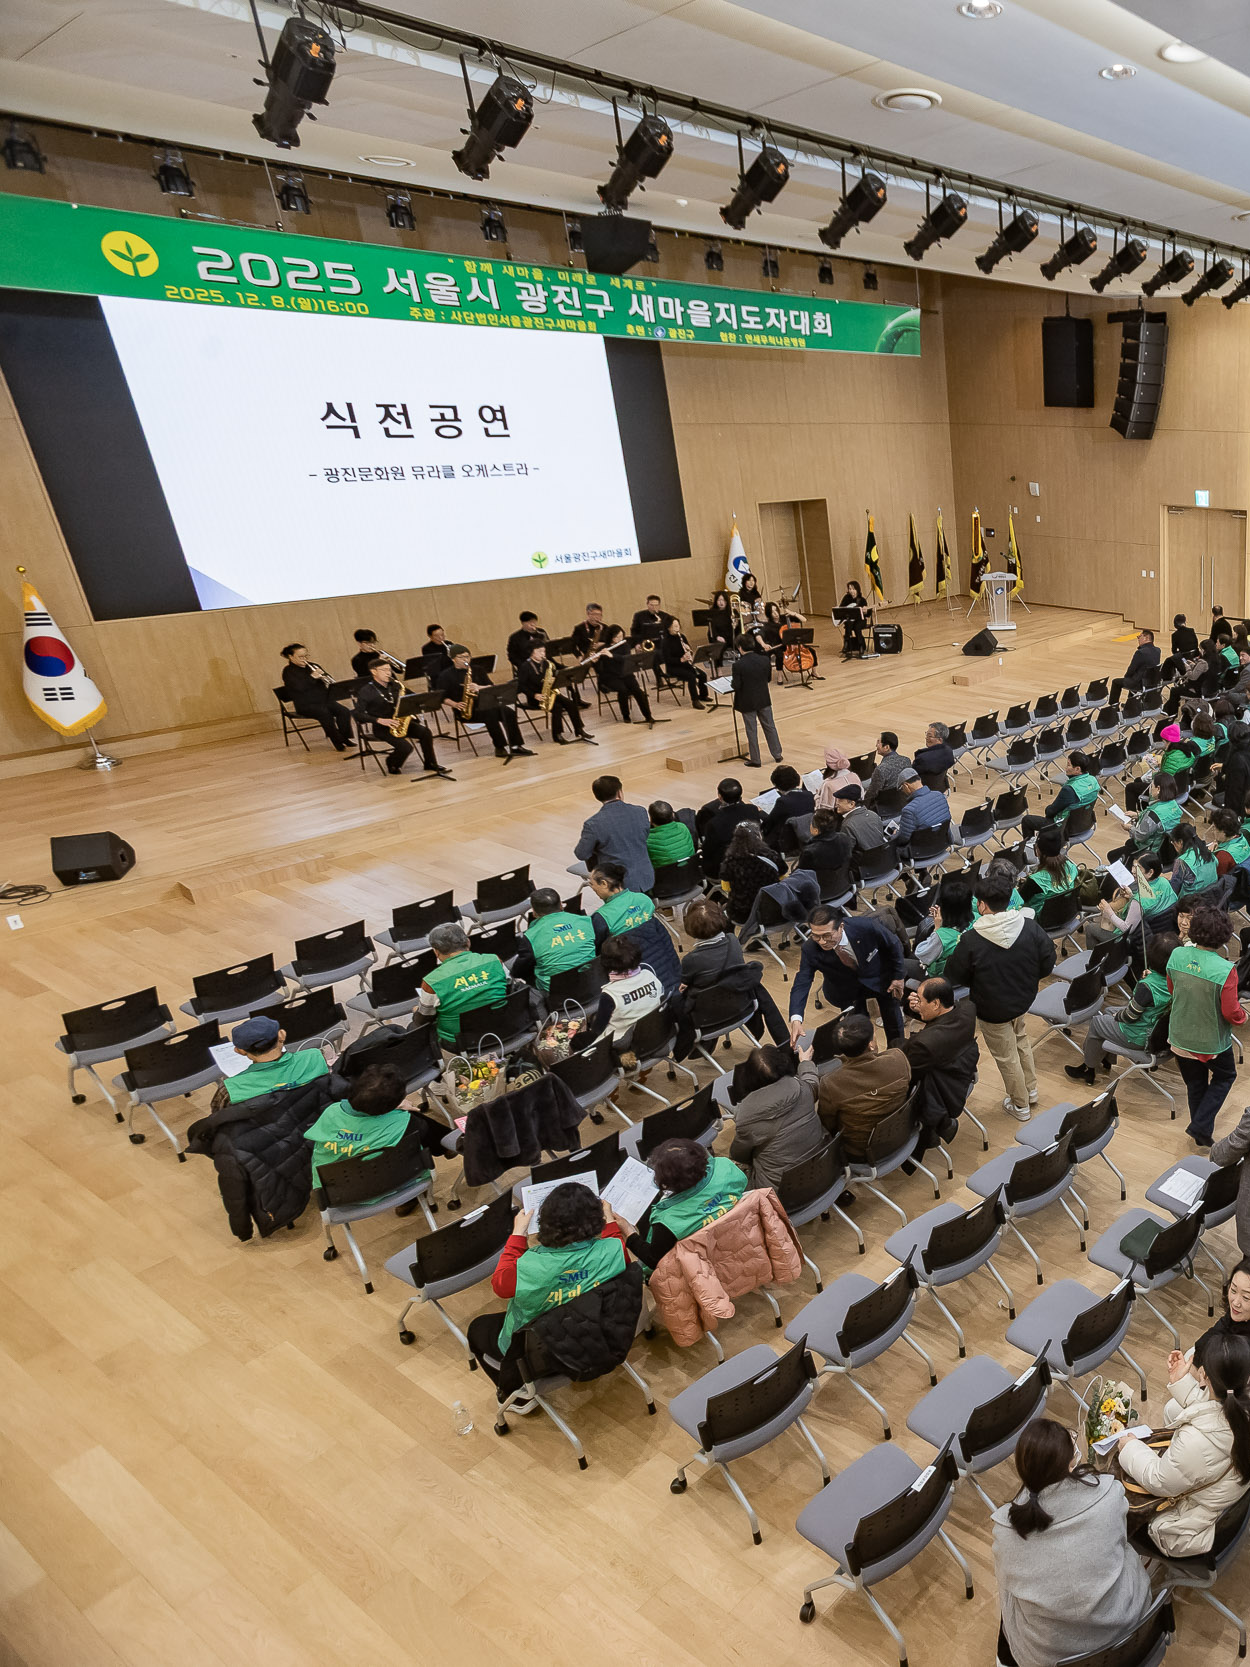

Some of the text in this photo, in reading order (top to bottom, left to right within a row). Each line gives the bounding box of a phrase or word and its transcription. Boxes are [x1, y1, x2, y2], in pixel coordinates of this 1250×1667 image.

[164, 285, 232, 304] 2025.
[236, 292, 267, 307] 12.
[192, 246, 833, 338] 2025 서울시 광진구 새마을지도자대회
[668, 328, 695, 340] 광진구
[323, 466, 406, 483] 광진문화원
[461, 462, 529, 478] 오케스트라
[552, 924, 573, 934] SMU
[551, 929, 586, 948] 새마을
[453, 971, 490, 989] 새마을
[623, 981, 658, 1006] BUDDY
[335, 1130, 363, 1142] SMU
[559, 1270, 588, 1284] SMU
